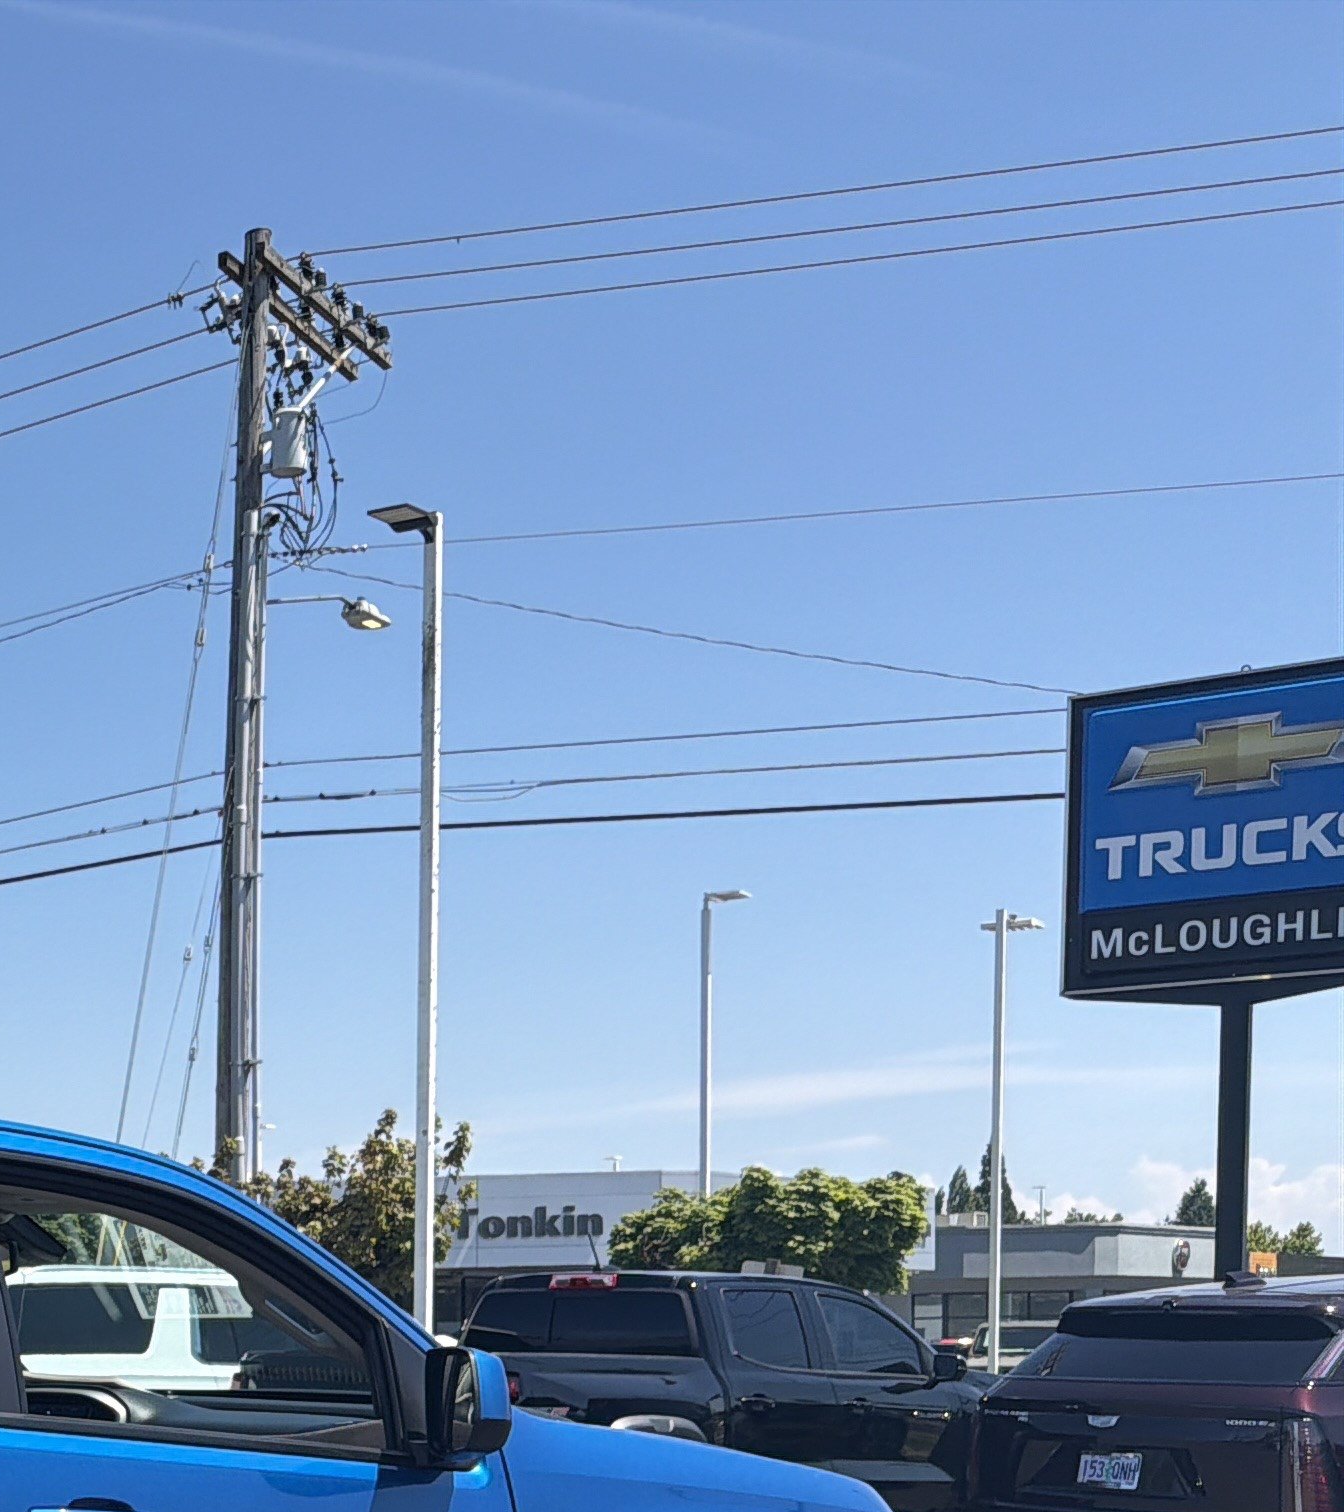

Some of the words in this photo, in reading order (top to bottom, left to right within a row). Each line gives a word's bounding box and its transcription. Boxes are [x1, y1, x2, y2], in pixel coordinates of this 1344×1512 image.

[1095, 811, 1344, 881] TRUCK
[453, 1205, 604, 1240] Tonkin
[1082, 1460, 1106, 1479] 153
